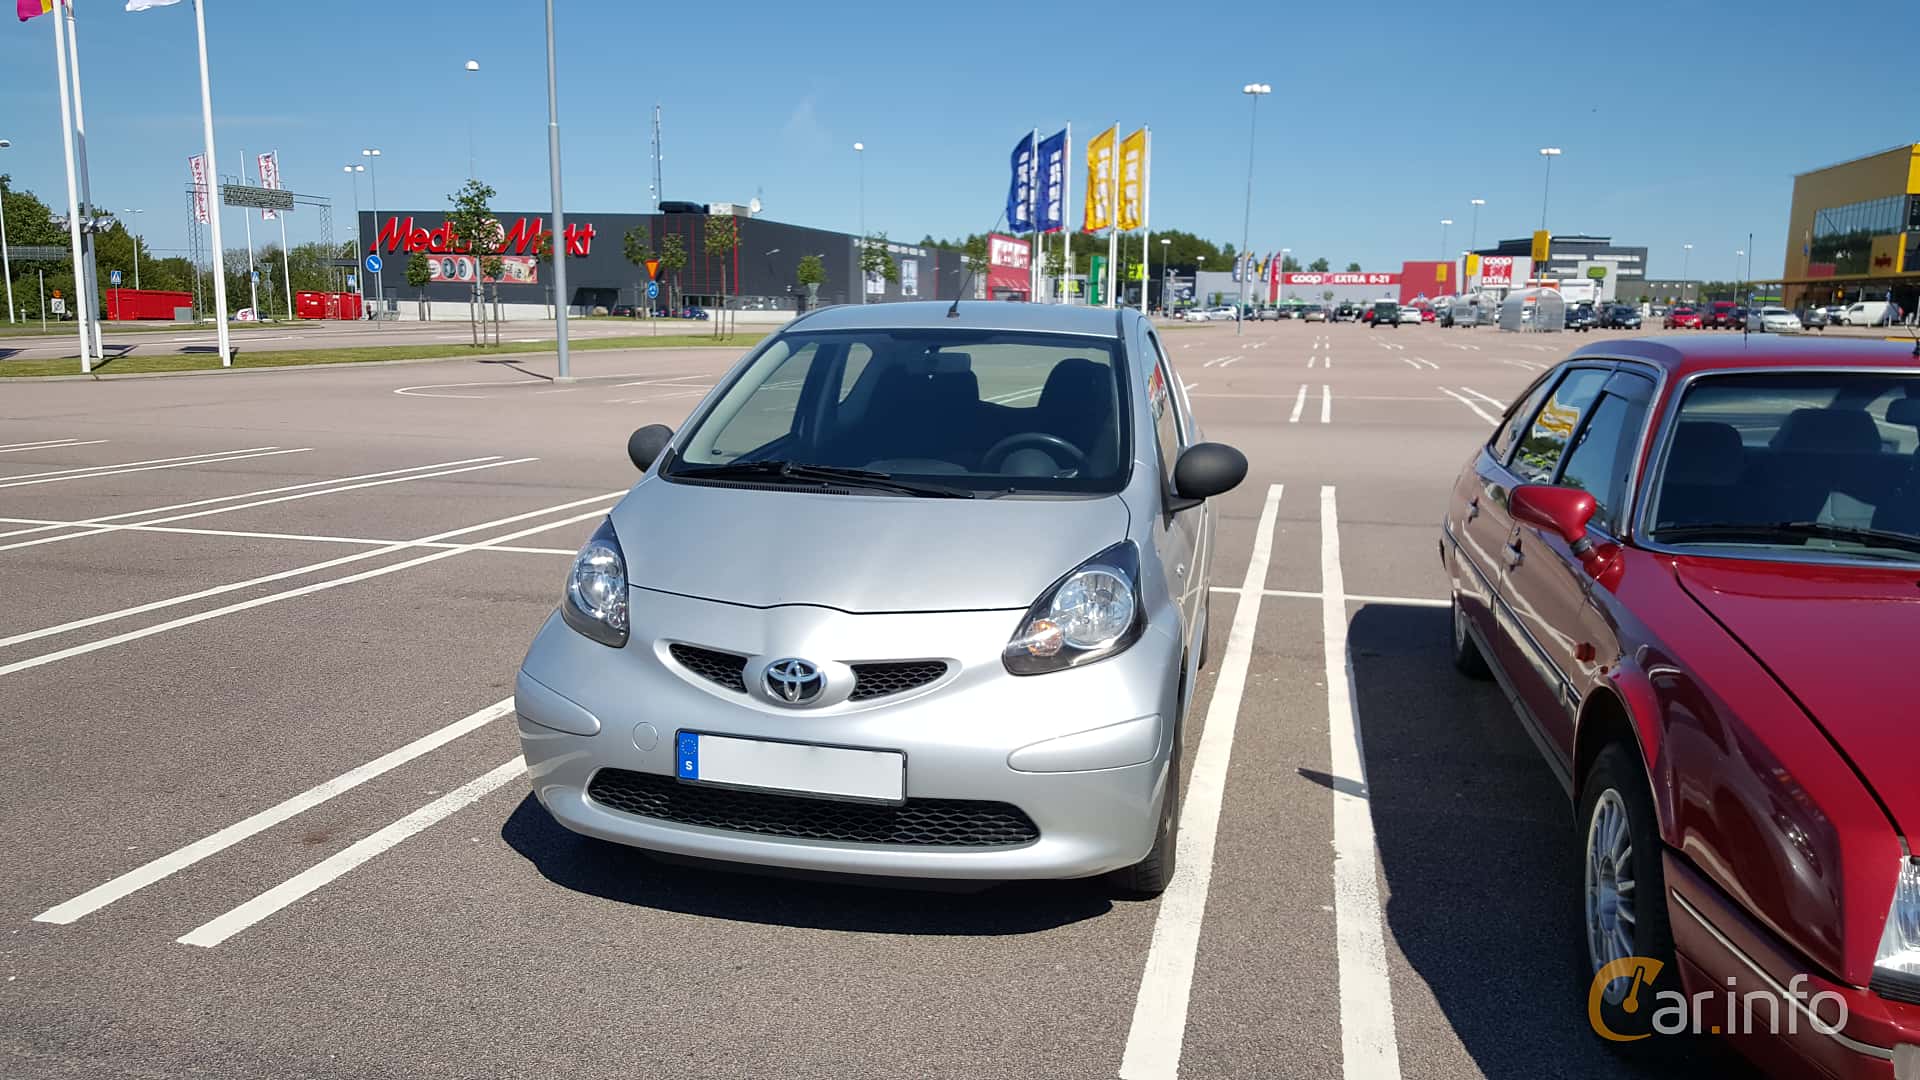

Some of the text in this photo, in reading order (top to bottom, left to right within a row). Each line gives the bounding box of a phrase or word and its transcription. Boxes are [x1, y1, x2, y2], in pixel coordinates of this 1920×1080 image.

[496, 216, 596, 255] Makt
[1334, 274, 1366, 284] EXTRA
[685, 760, 693, 770] S
